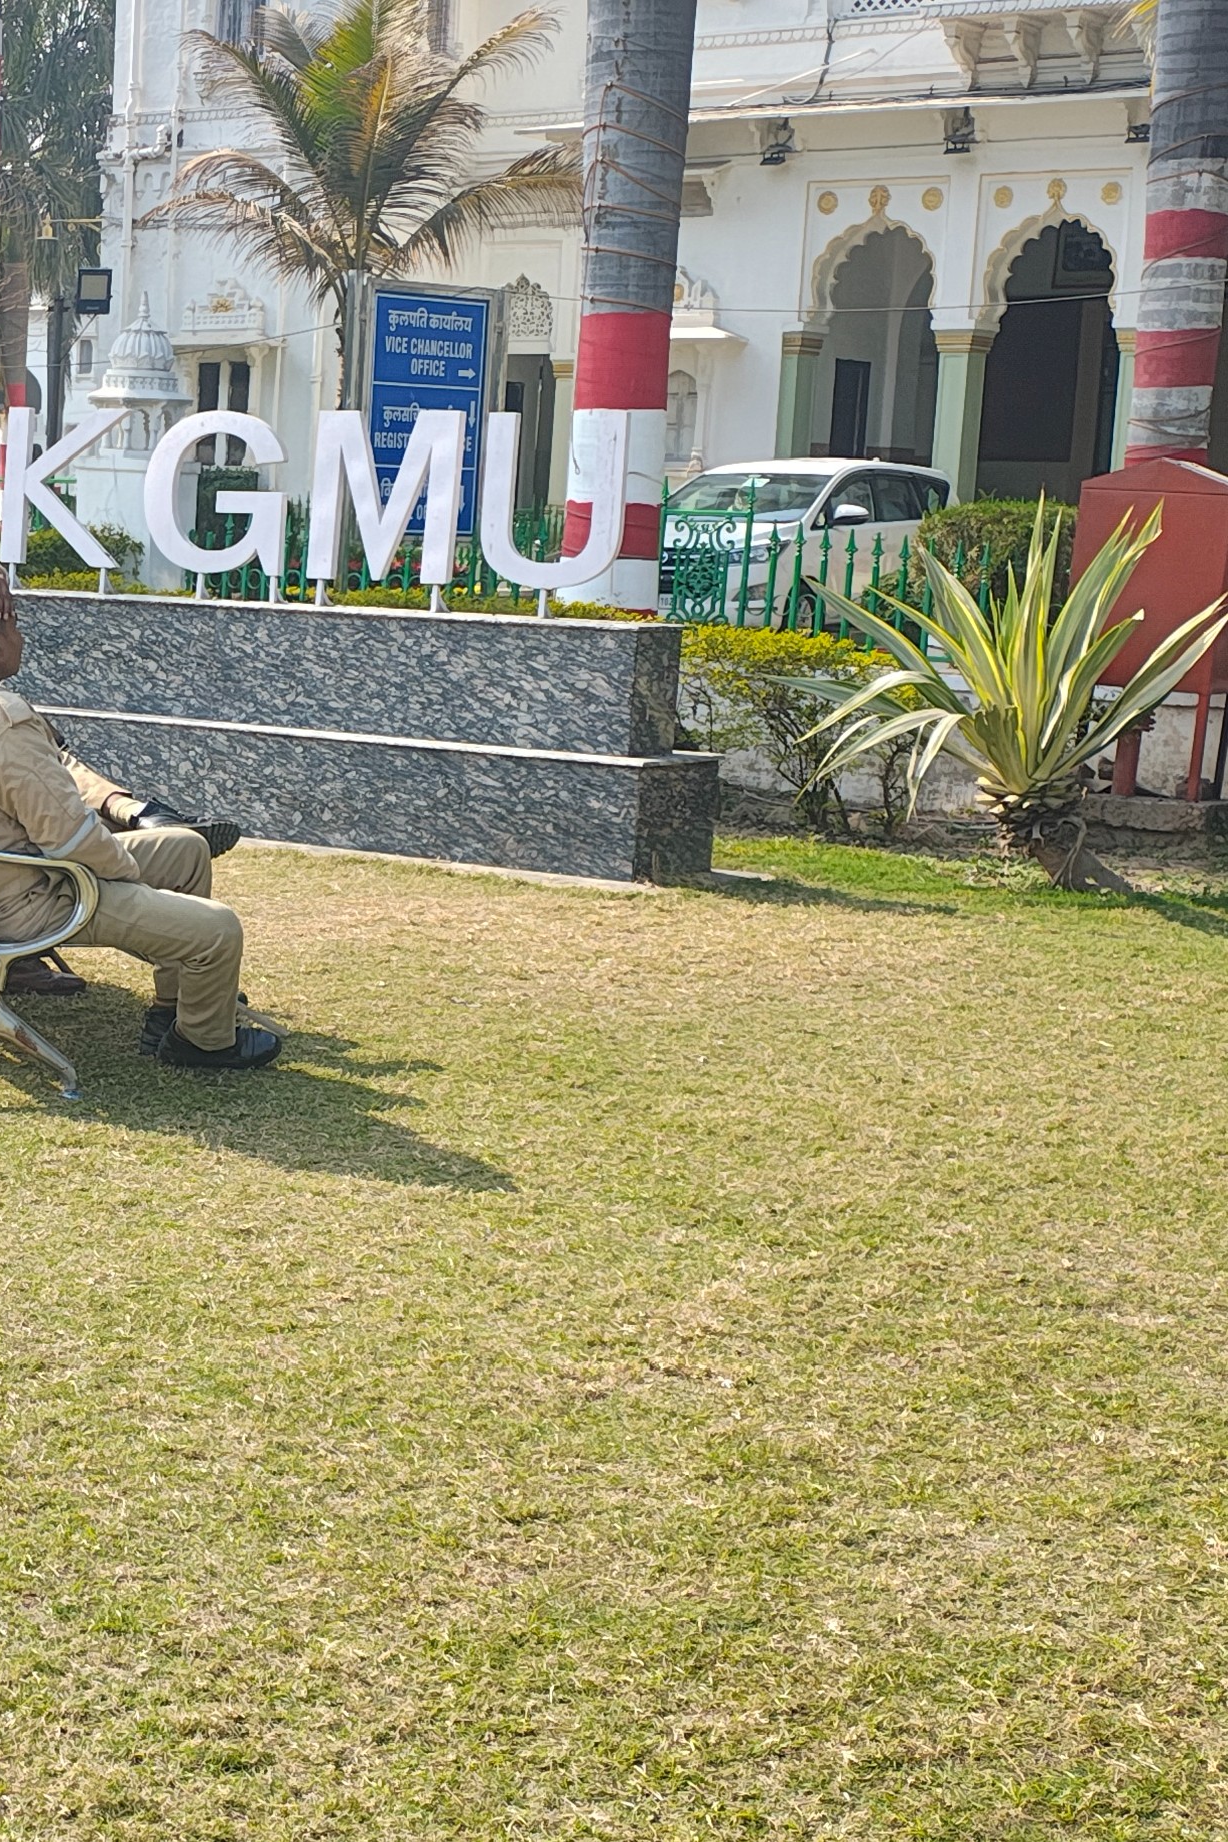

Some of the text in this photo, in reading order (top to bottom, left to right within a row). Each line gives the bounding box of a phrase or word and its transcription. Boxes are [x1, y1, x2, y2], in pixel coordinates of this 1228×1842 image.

[388, 307, 473, 333] कुलपति कार्यालय
[385, 335, 473, 360] VICE CHANCELLOR
[410, 358, 446, 377] OFFICE
[374, 431, 412, 450] REGIST
[0, 407, 629, 590] KGMU
